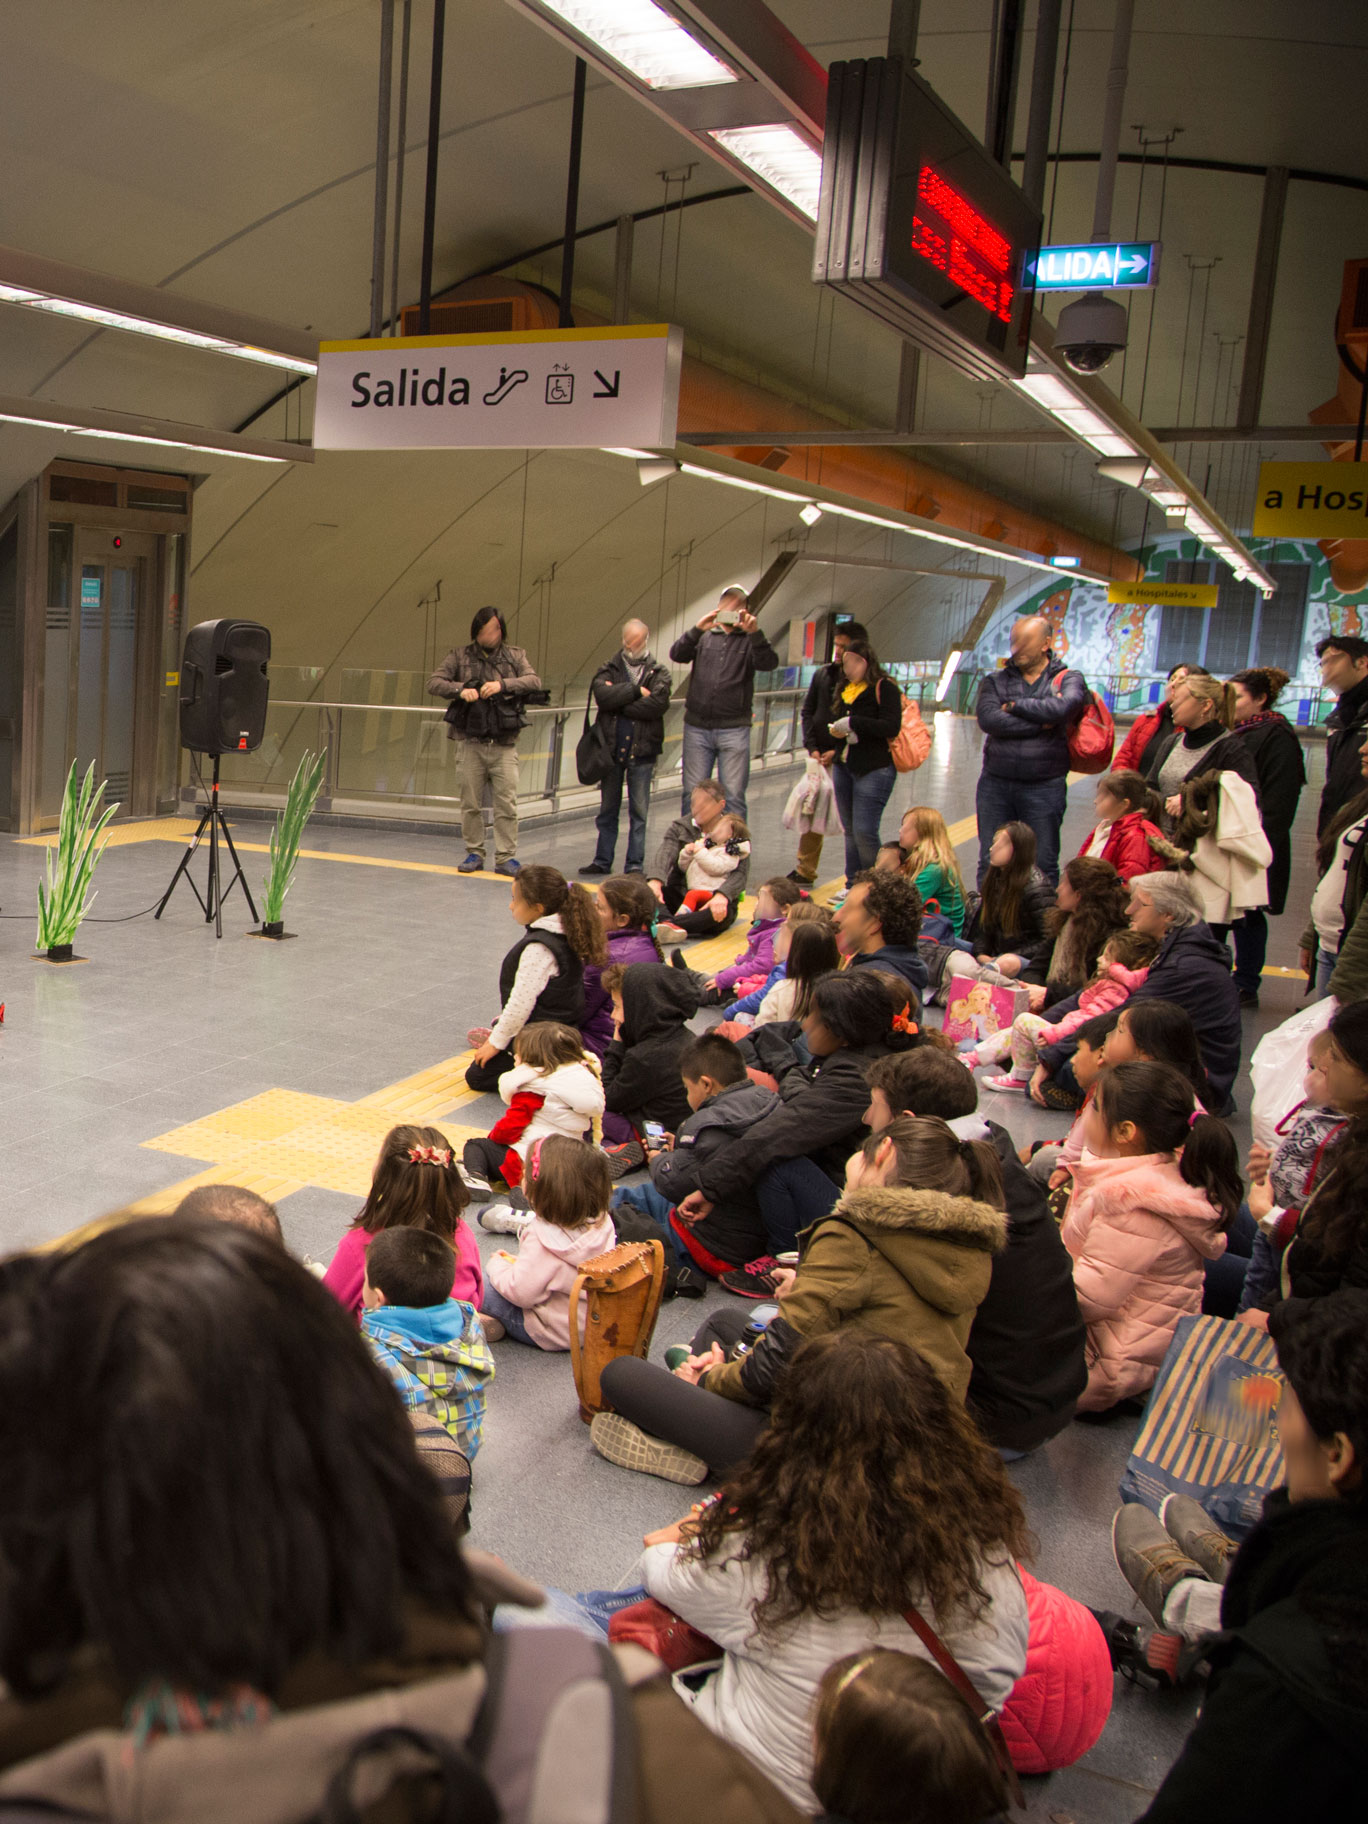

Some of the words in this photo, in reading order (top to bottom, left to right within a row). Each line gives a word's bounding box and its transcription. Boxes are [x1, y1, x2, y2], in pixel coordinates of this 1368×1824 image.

[351, 367, 470, 408] Salida
[1264, 490, 1283, 509] a
[1297, 485, 1368, 517] Hos
[1136, 589, 1188, 599] Hospitales
